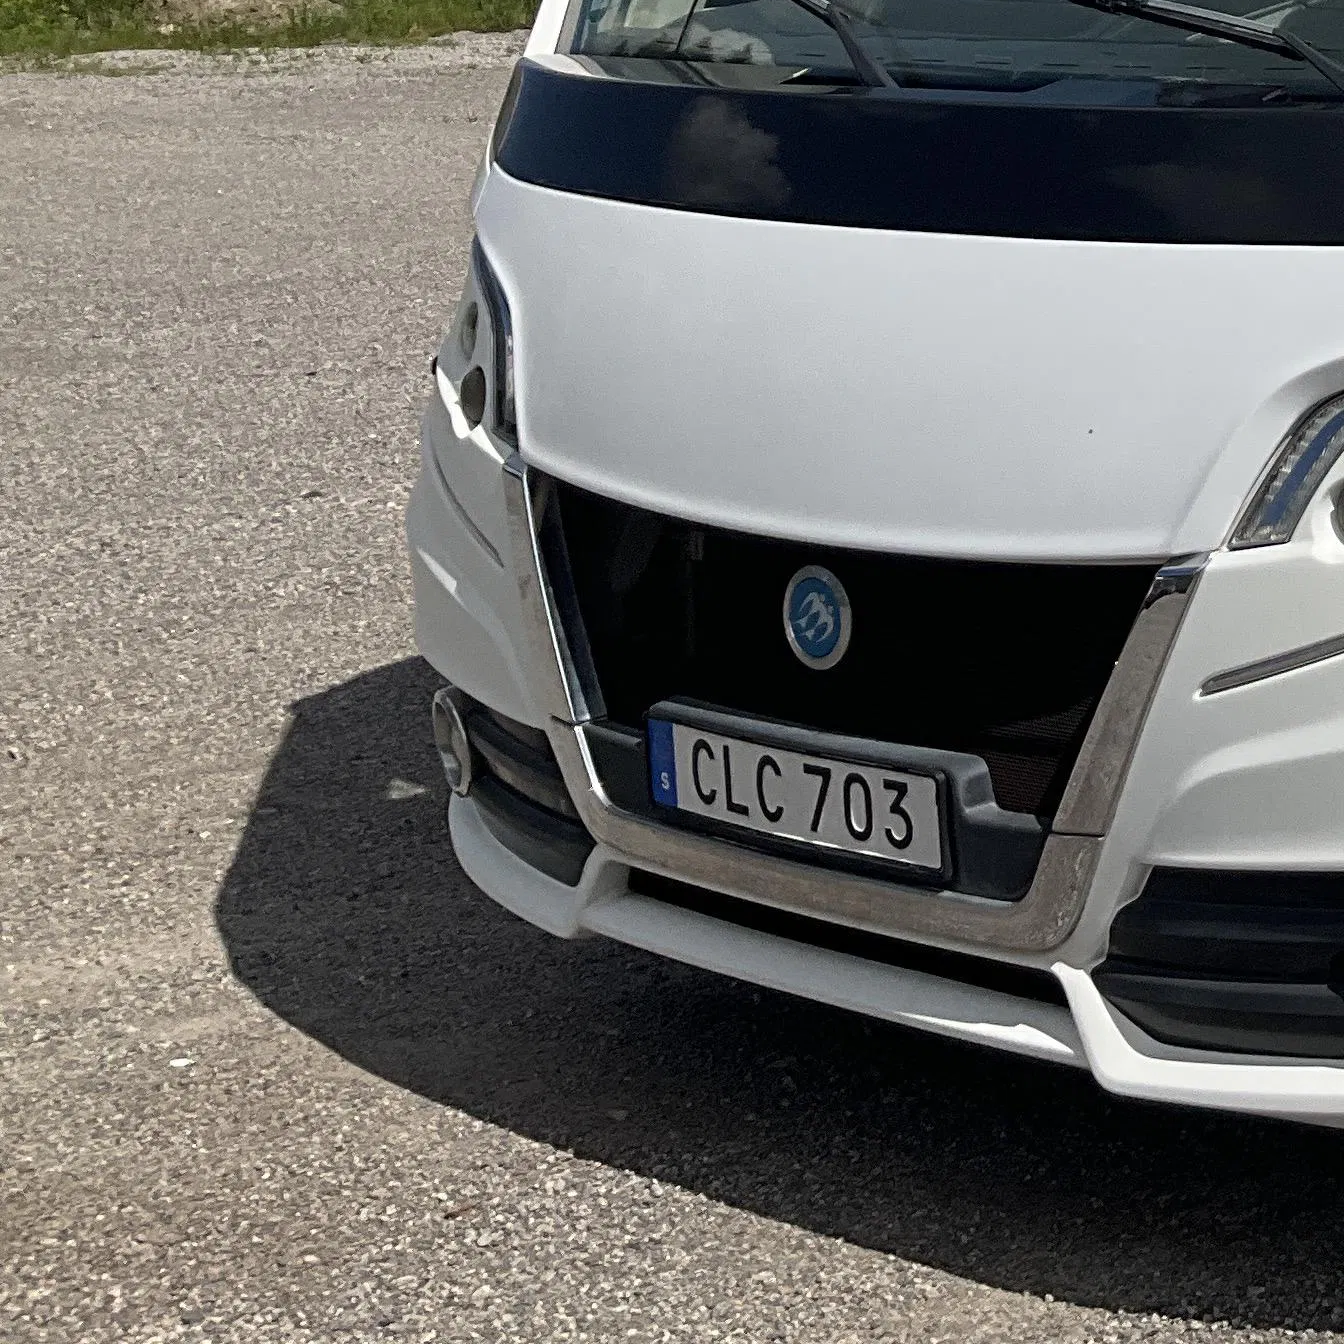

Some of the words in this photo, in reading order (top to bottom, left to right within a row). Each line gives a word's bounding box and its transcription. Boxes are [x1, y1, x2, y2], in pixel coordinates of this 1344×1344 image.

[660, 773, 670, 791] S
[692, 738, 784, 823] CLC
[803, 763, 913, 849] 703
